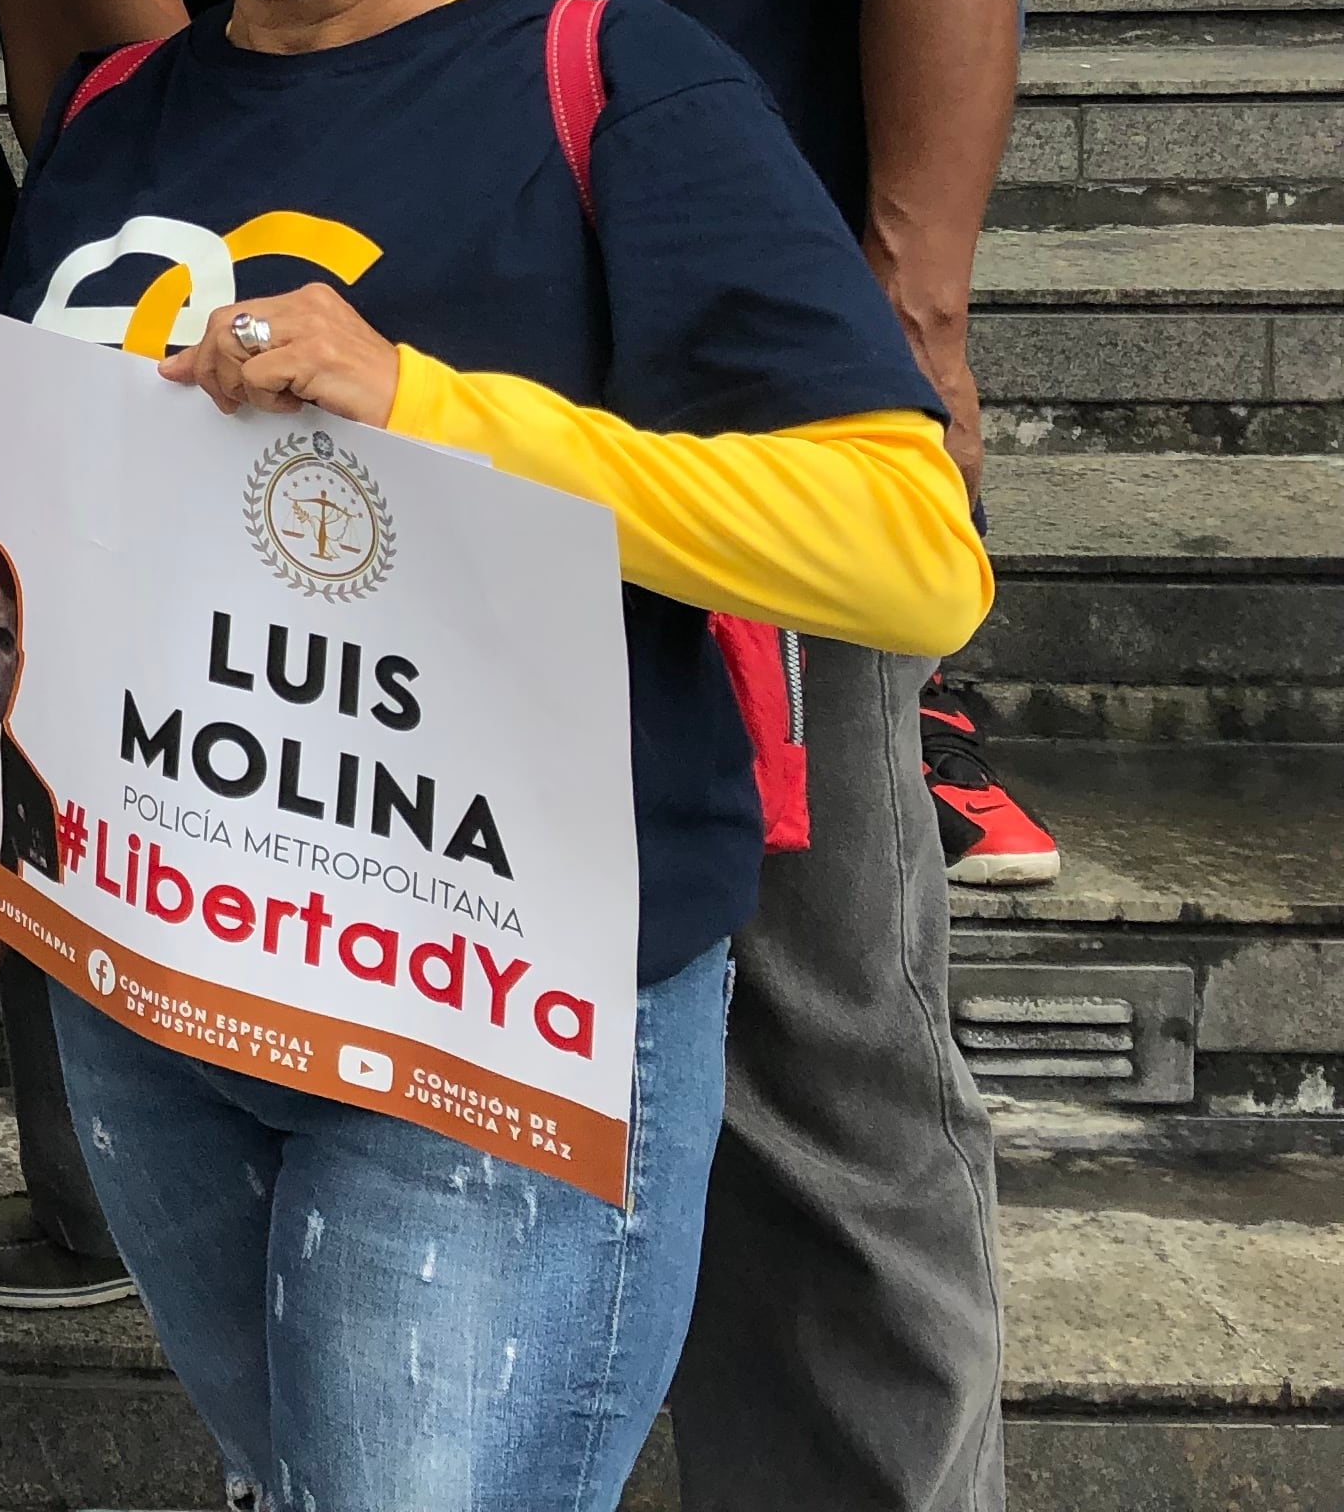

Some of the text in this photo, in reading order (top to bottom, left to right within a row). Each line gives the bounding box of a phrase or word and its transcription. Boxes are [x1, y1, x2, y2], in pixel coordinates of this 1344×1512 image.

[209, 610, 422, 733] LUIS
[119, 689, 515, 882] MOLINA
[122, 785, 525, 939] POLICÍA METROPOLITANA
[57, 798, 596, 1061] #LibertadYa
[118, 974, 315, 1058] COMISIÓN ESPECIAL
[126, 995, 310, 1074] DE JUSTICIA Y PAZ
[404, 1084, 573, 1161] JUSTICIA Y PAZ
[412, 1067, 558, 1136] COMISIÓN DE
